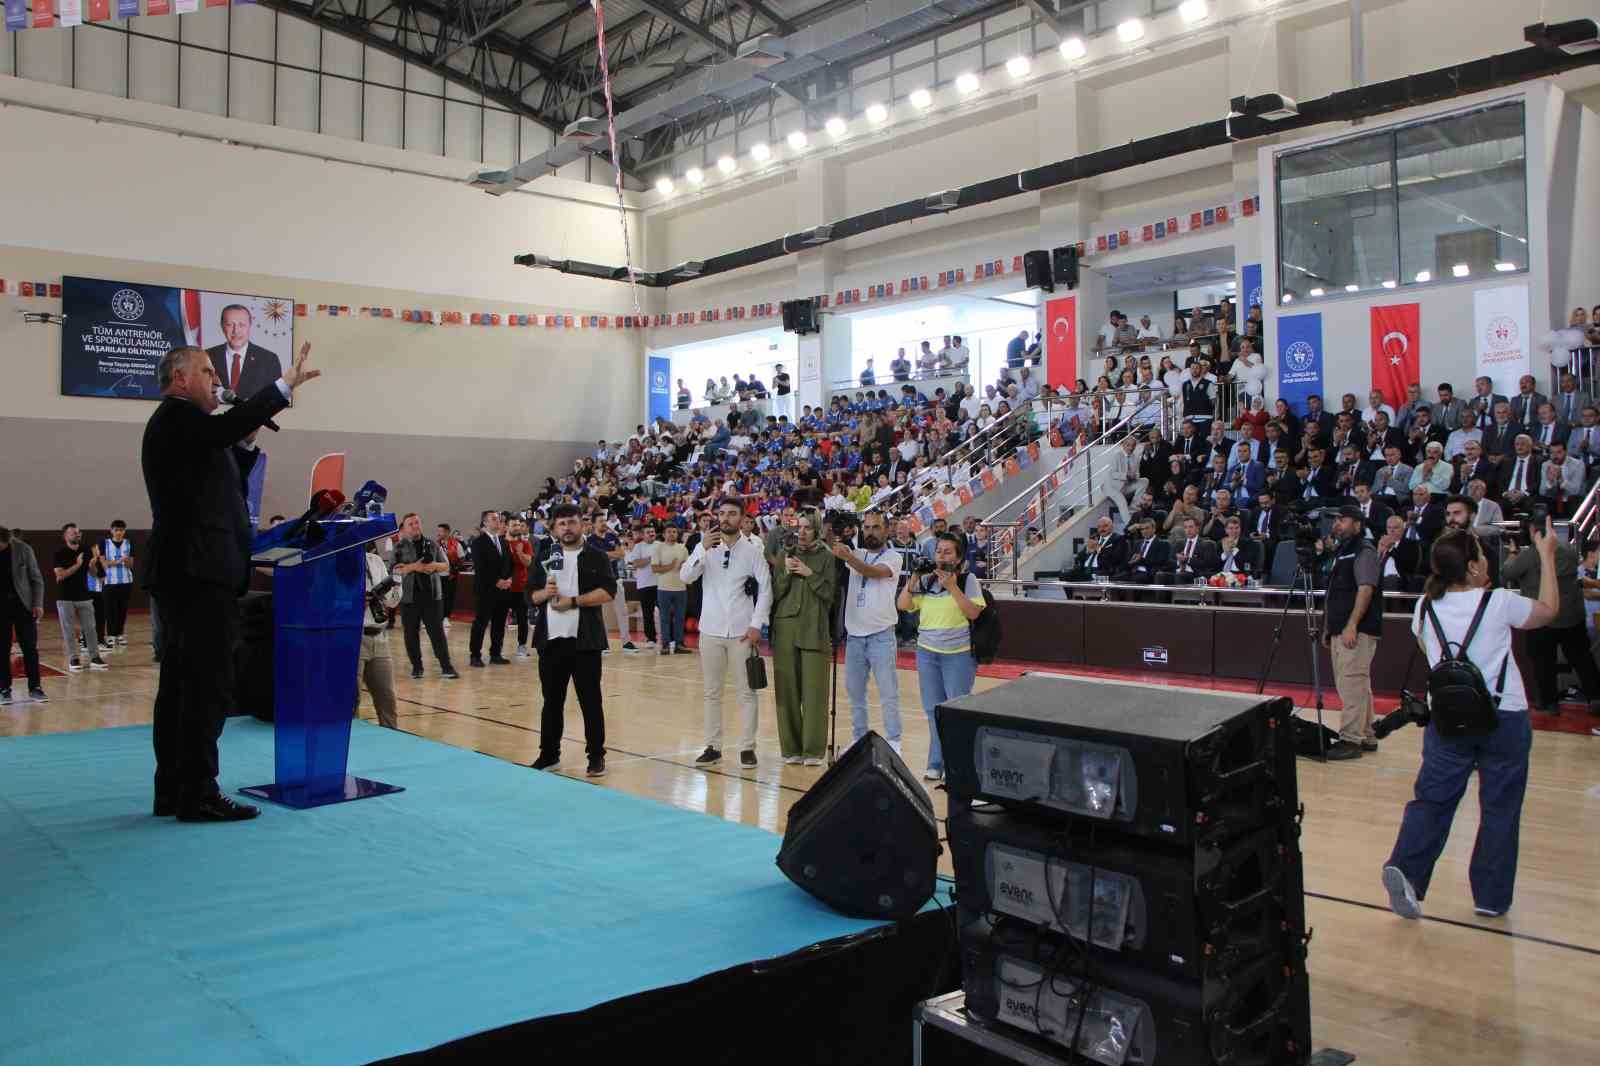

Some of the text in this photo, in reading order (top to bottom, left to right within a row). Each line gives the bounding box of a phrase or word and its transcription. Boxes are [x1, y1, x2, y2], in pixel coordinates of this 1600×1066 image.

[91, 326, 162, 340] TÜM ANTRENÖR
[81, 334, 172, 349] VE SPORCULARIMIZA
[84, 345, 127, 354] BAŞARILAR
